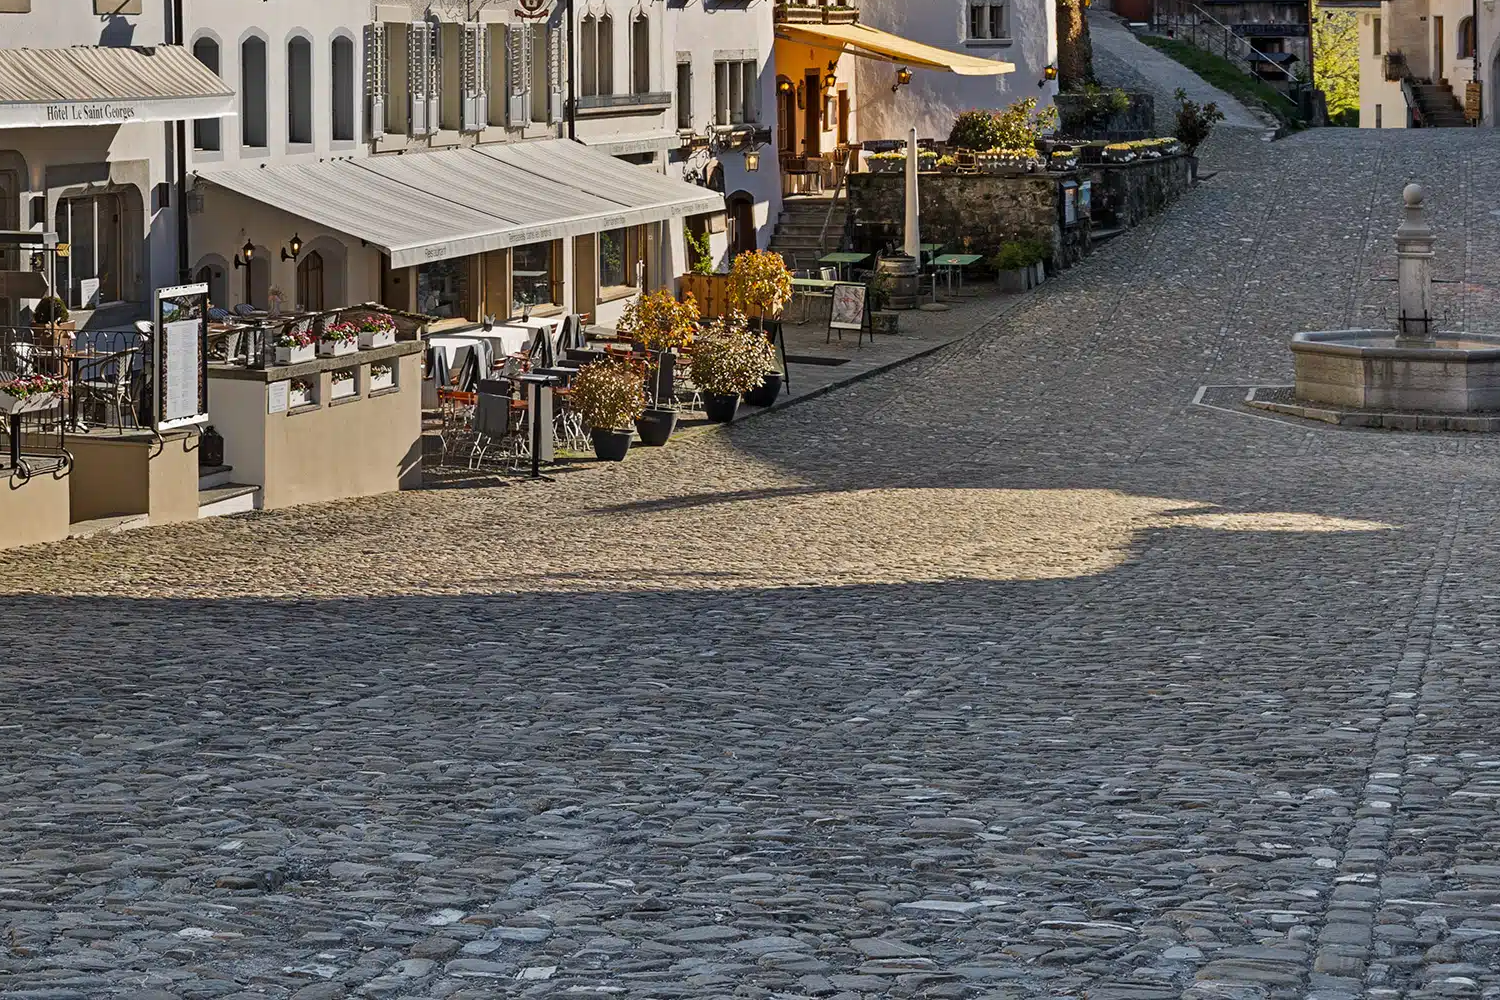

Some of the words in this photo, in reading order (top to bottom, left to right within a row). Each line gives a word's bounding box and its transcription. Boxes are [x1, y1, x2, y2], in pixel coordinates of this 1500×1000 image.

[47, 105, 69, 120] Hôtel
[71, 105, 82, 119] Le
[83, 104, 103, 118] Saint
[104, 104, 135, 120] Georges
